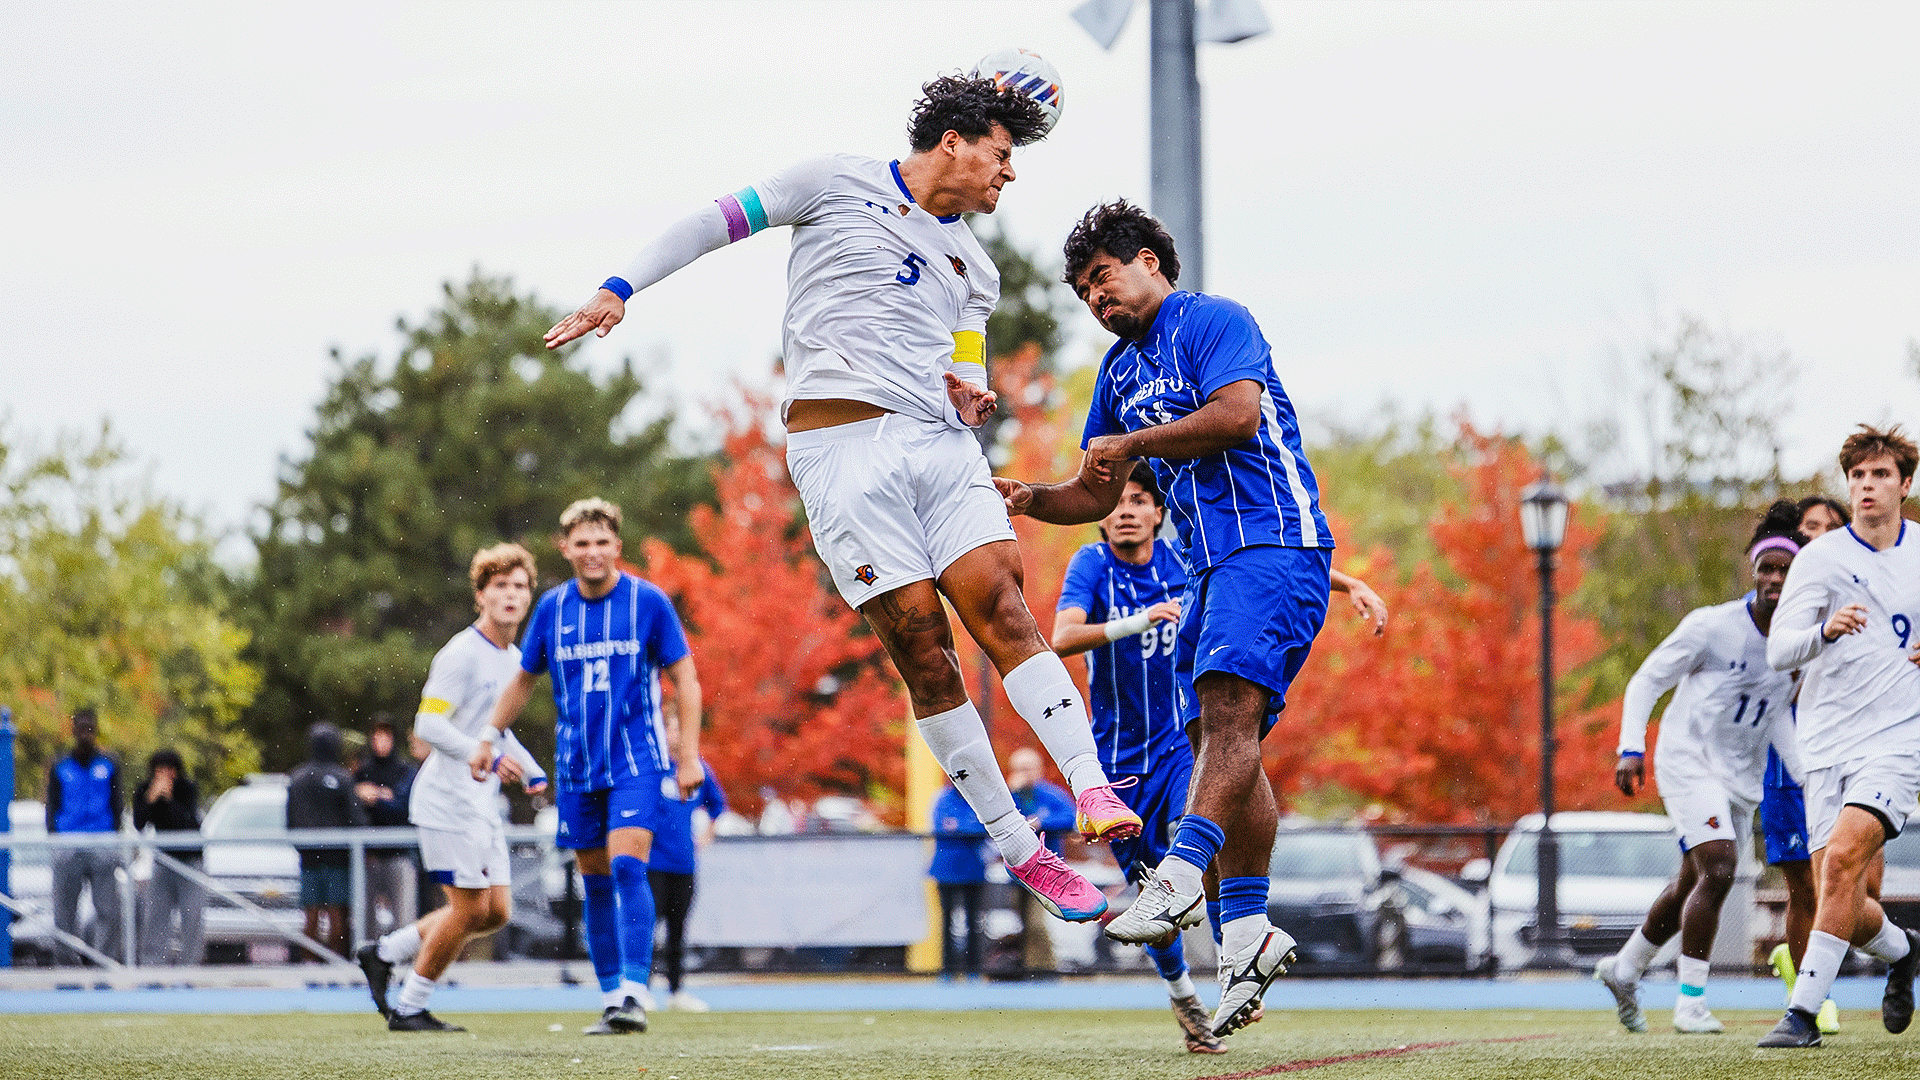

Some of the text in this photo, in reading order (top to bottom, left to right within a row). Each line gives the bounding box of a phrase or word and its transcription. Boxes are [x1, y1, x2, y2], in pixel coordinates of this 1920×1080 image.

[896, 252, 927, 286] 5
[1141, 621, 1177, 660] 99
[1891, 613, 1912, 649] 9
[583, 658, 610, 693] 12
[1733, 693, 1769, 727] 11
